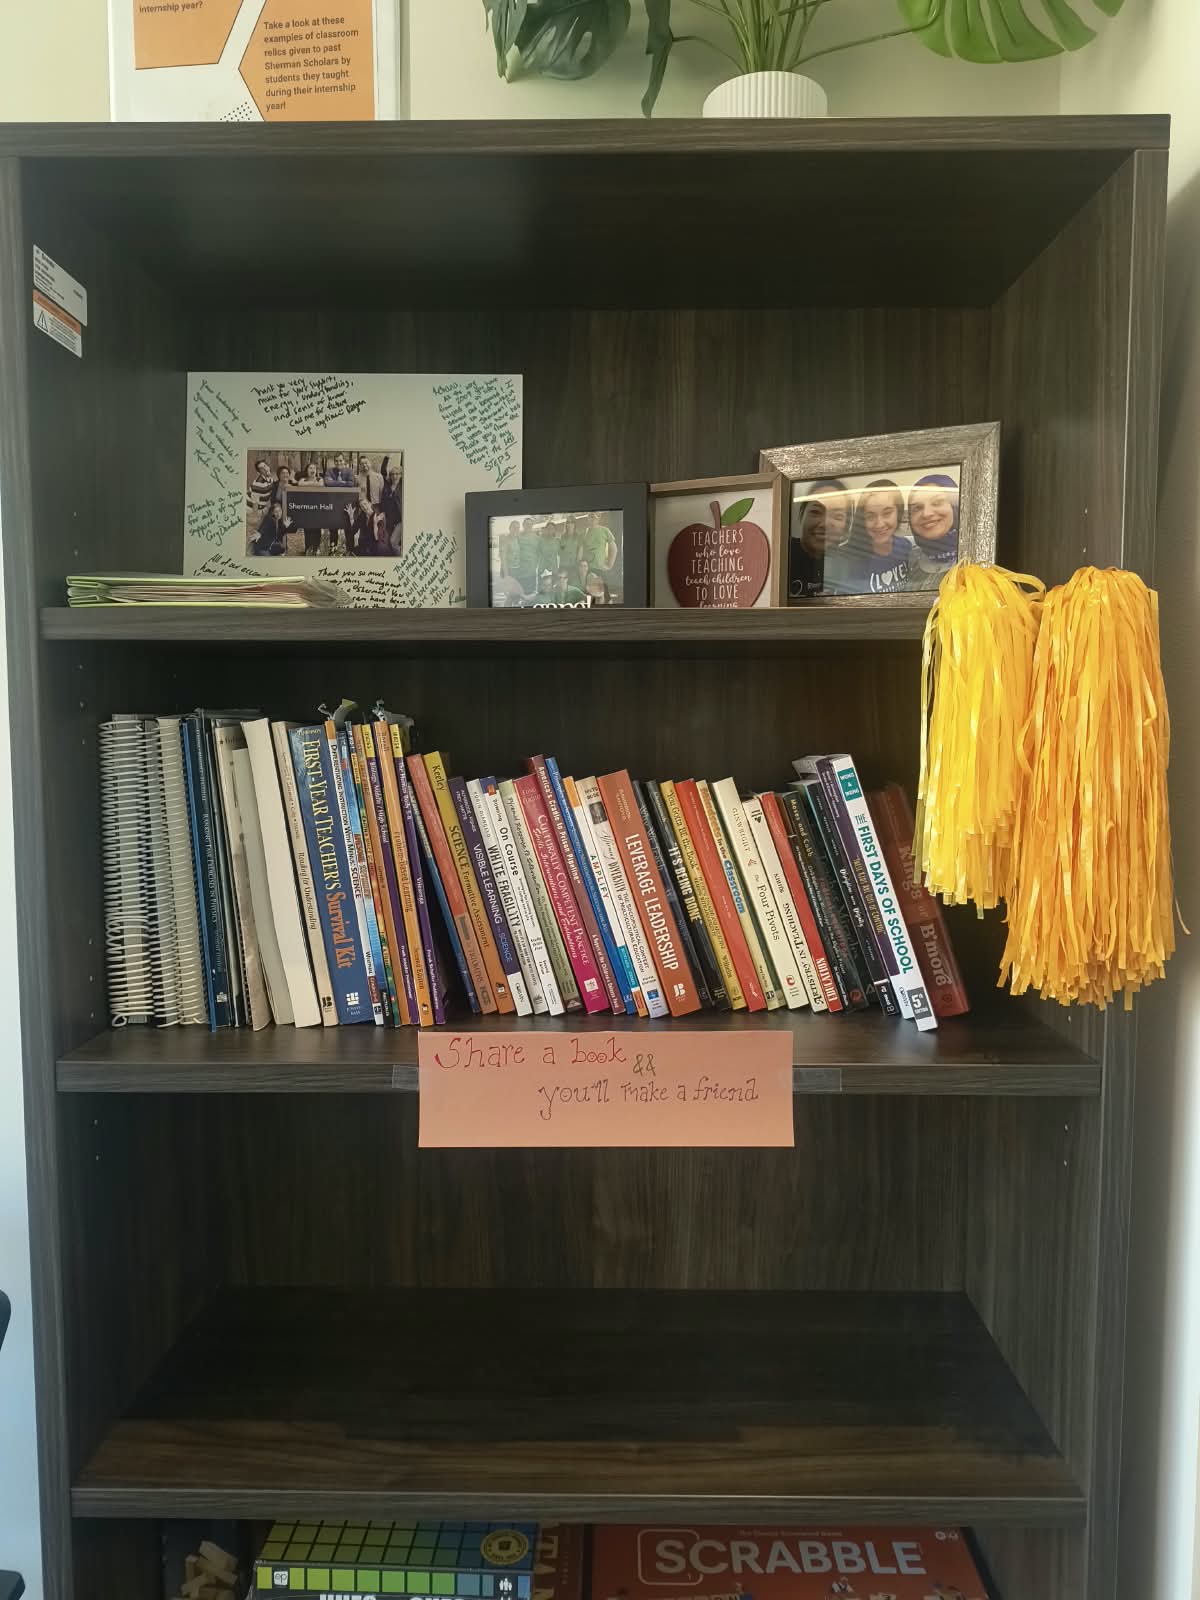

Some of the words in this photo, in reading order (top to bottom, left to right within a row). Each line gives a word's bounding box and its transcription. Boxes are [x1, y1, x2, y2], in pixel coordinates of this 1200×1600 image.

[139, 4, 179, 14] internship
[181, 2, 203, 10] year?
[264, 22, 283, 30] Take
[292, 19, 309, 27] look
[322, 16, 344, 25] these
[264, 34, 303, 44] examples
[316, 29, 358, 39] classroom
[264, 48, 287, 56] relics
[289, 46, 310, 56] given
[313, 45, 321, 53] to
[323, 44, 341, 53] past
[265, 61, 301, 70] Sherman
[303, 57, 339, 68] Scholars
[341, 56, 351, 66] by
[266, 74, 300, 84] students
[302, 73, 320, 82] they
[322, 70, 349, 81] taught
[266, 87, 291, 97] during
[293, 85, 312, 94] their
[314, 83, 356, 94] internship
[266, 102, 286, 112] year!
[288, 378, 306, 386] very
[273, 412, 291, 422] and
[289, 416, 303, 427] Call
[692, 528, 744, 546] TEACHERS
[696, 546, 716, 557] who
[719, 545, 740, 557] love
[692, 557, 744, 574] TEACHING
[685, 575, 710, 586] teach
[711, 574, 752, 583] children
[696, 586, 707, 600] TO
[714, 584, 739, 599] LOVE
[299, 738, 332, 816] FIRST-YEAR
[536, 765, 554, 799] America's
[337, 790, 350, 826] INSTRUCTION
[548, 799, 561, 821] Cradle
[671, 806, 684, 826] Gotta
[699, 786, 722, 838] Mindsets
[788, 798, 802, 821] Moses
[343, 826, 352, 843] WITH
[498, 826, 511, 842] On
[513, 822, 528, 849] Response
[555, 822, 563, 830] to
[678, 826, 688, 838] BE
[797, 822, 807, 837] and
[313, 815, 343, 891] TEACHER'S
[558, 830, 571, 852] Prison
[681, 837, 691, 849] the
[718, 845, 728, 859] the
[801, 838, 814, 857] Cobb
[856, 824, 878, 859] FIRST
[430, 764, 447, 792] Keeley
[448, 824, 470, 869] SCIENCE
[461, 869, 478, 907] Formative
[472, 907, 490, 948] Assessment
[503, 842, 520, 876] Course
[666, 842, 683, 866] "IT'S
[685, 850, 699, 872] Book"
[350, 866, 362, 898] SCIENCE
[487, 844, 506, 878] WHITE
[497, 878, 522, 928] FRAGILITY
[589, 854, 608, 900] AMPLIFY
[673, 865, 693, 896] BEING
[721, 858, 747, 914] Classroom
[730, 806, 751, 852] GINWRIGHT
[755, 883, 772, 910] Four
[764, 910, 782, 942] Pivots
[868, 860, 891, 897] DAYS
[296, 851, 308, 877] Reading
[302, 886, 318, 930] Understanding
[535, 813, 563, 871] CULTURALLY
[554, 871, 580, 928] COMPETENT
[572, 927, 591, 966] PRACTICE
[471, 843, 490, 878] VISIBLE
[481, 877, 503, 924] LEARNING
[498, 931, 513, 962] SCIENCE
[555, 901, 566, 917] and
[608, 860, 626, 892] DIVERSITY
[625, 902, 642, 944] SOCIOPOLITICAL
[638, 945, 649, 968] CONTEXT
[623, 832, 656, 896] LEVERAGE
[643, 896, 680, 973] LEADERSHIP
[683, 895, 703, 927] DONE"
[880, 896, 896, 916] OF
[324, 890, 354, 944] Survival
[780, 901, 804, 948] TEACHING
[334, 944, 357, 969] Kit
[886, 916, 915, 974] SCHOOL
[918, 920, 952, 988] B'more
[631, 943, 644, 973] EDUCATION
[799, 958, 824, 1006] ARTISTRY
[814, 956, 838, 1002] EDUCATION
[434, 1038, 526, 1069] Share
[543, 1047, 556, 1065] a
[570, 1037, 627, 1064] book
[538, 1079, 610, 1120] you'll
[620, 1080, 669, 1102] make
[676, 1084, 687, 1101] a
[693, 1077, 759, 1102] friend
[655, 1539, 927, 1575] SCRABBLE
